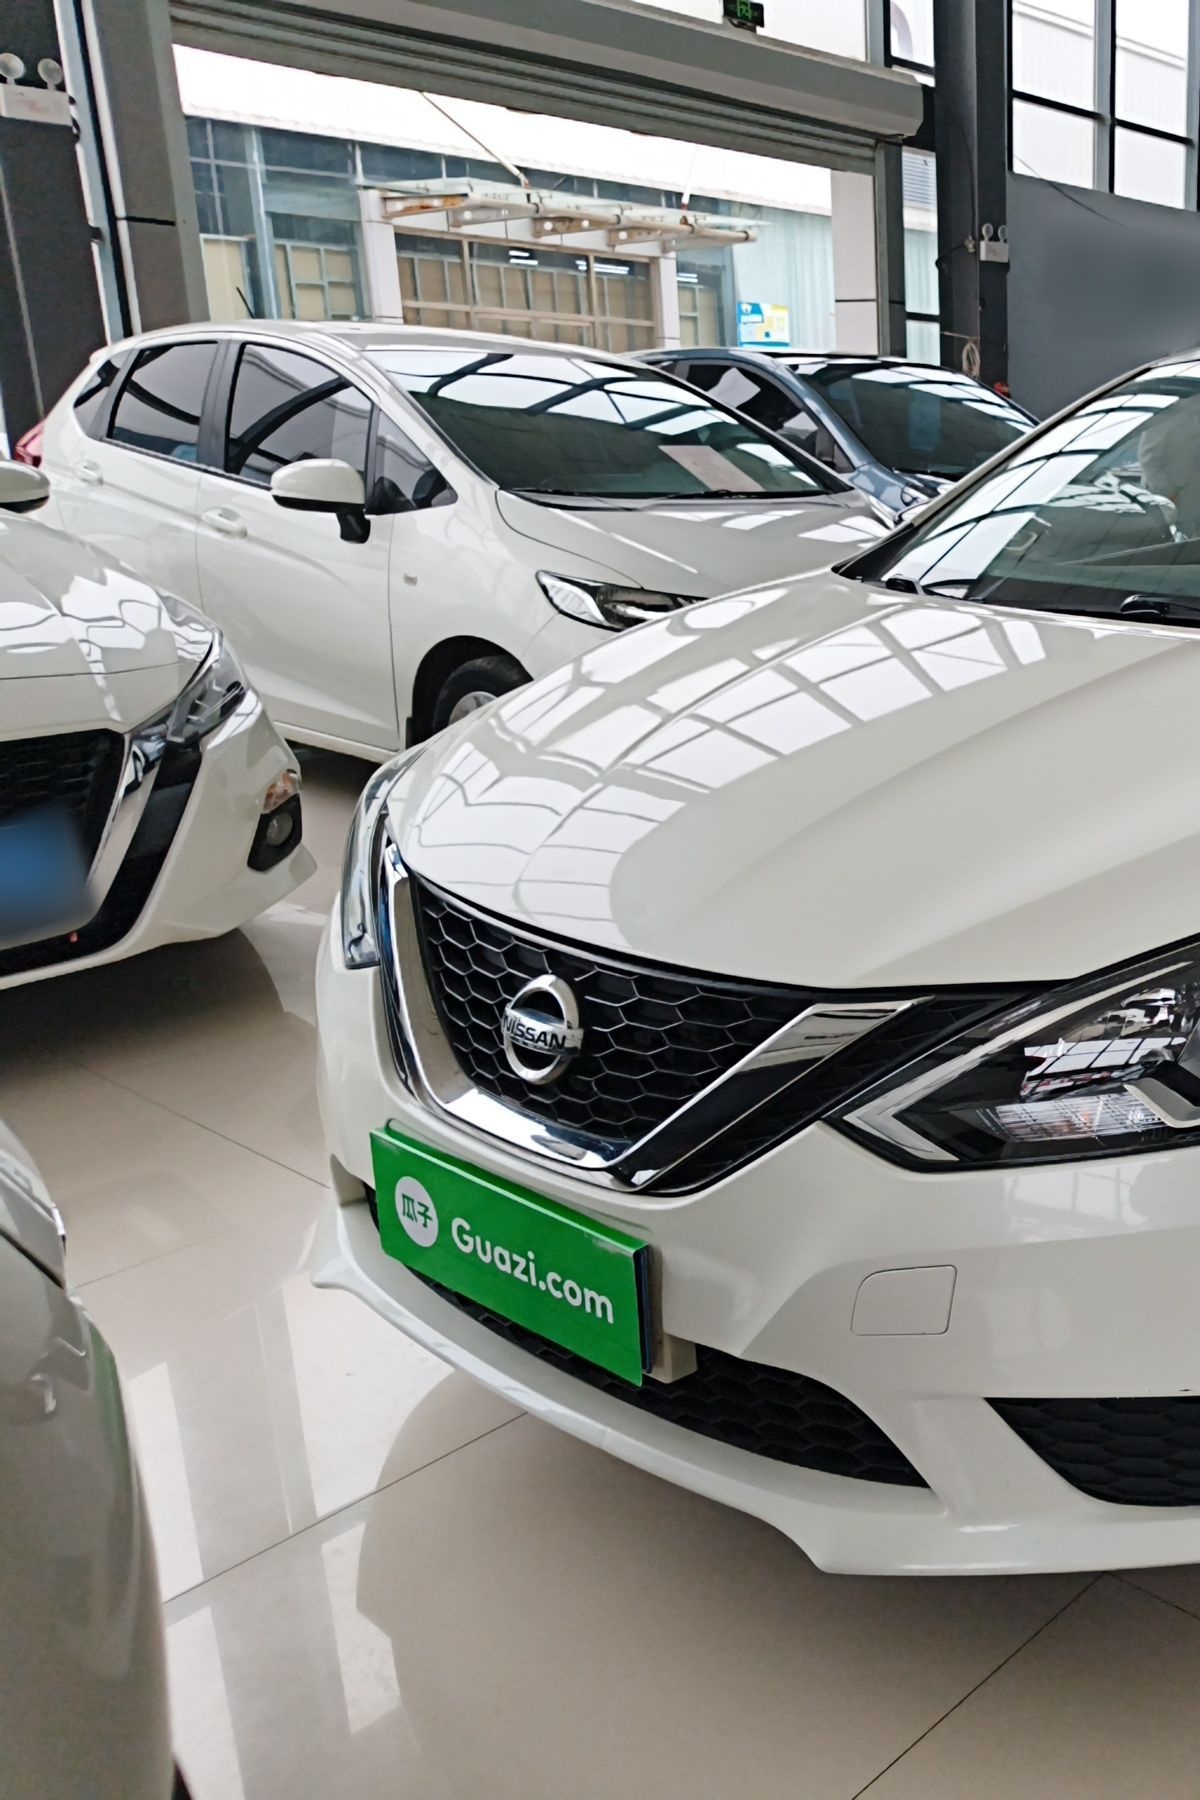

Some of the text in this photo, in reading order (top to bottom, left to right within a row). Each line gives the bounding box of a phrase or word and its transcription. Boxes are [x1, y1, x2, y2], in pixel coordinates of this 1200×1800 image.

[503, 1015, 566, 1049] NISSAN
[401, 1193, 433, 1228] 瓜子
[451, 1216, 614, 1324] Guazi.com
